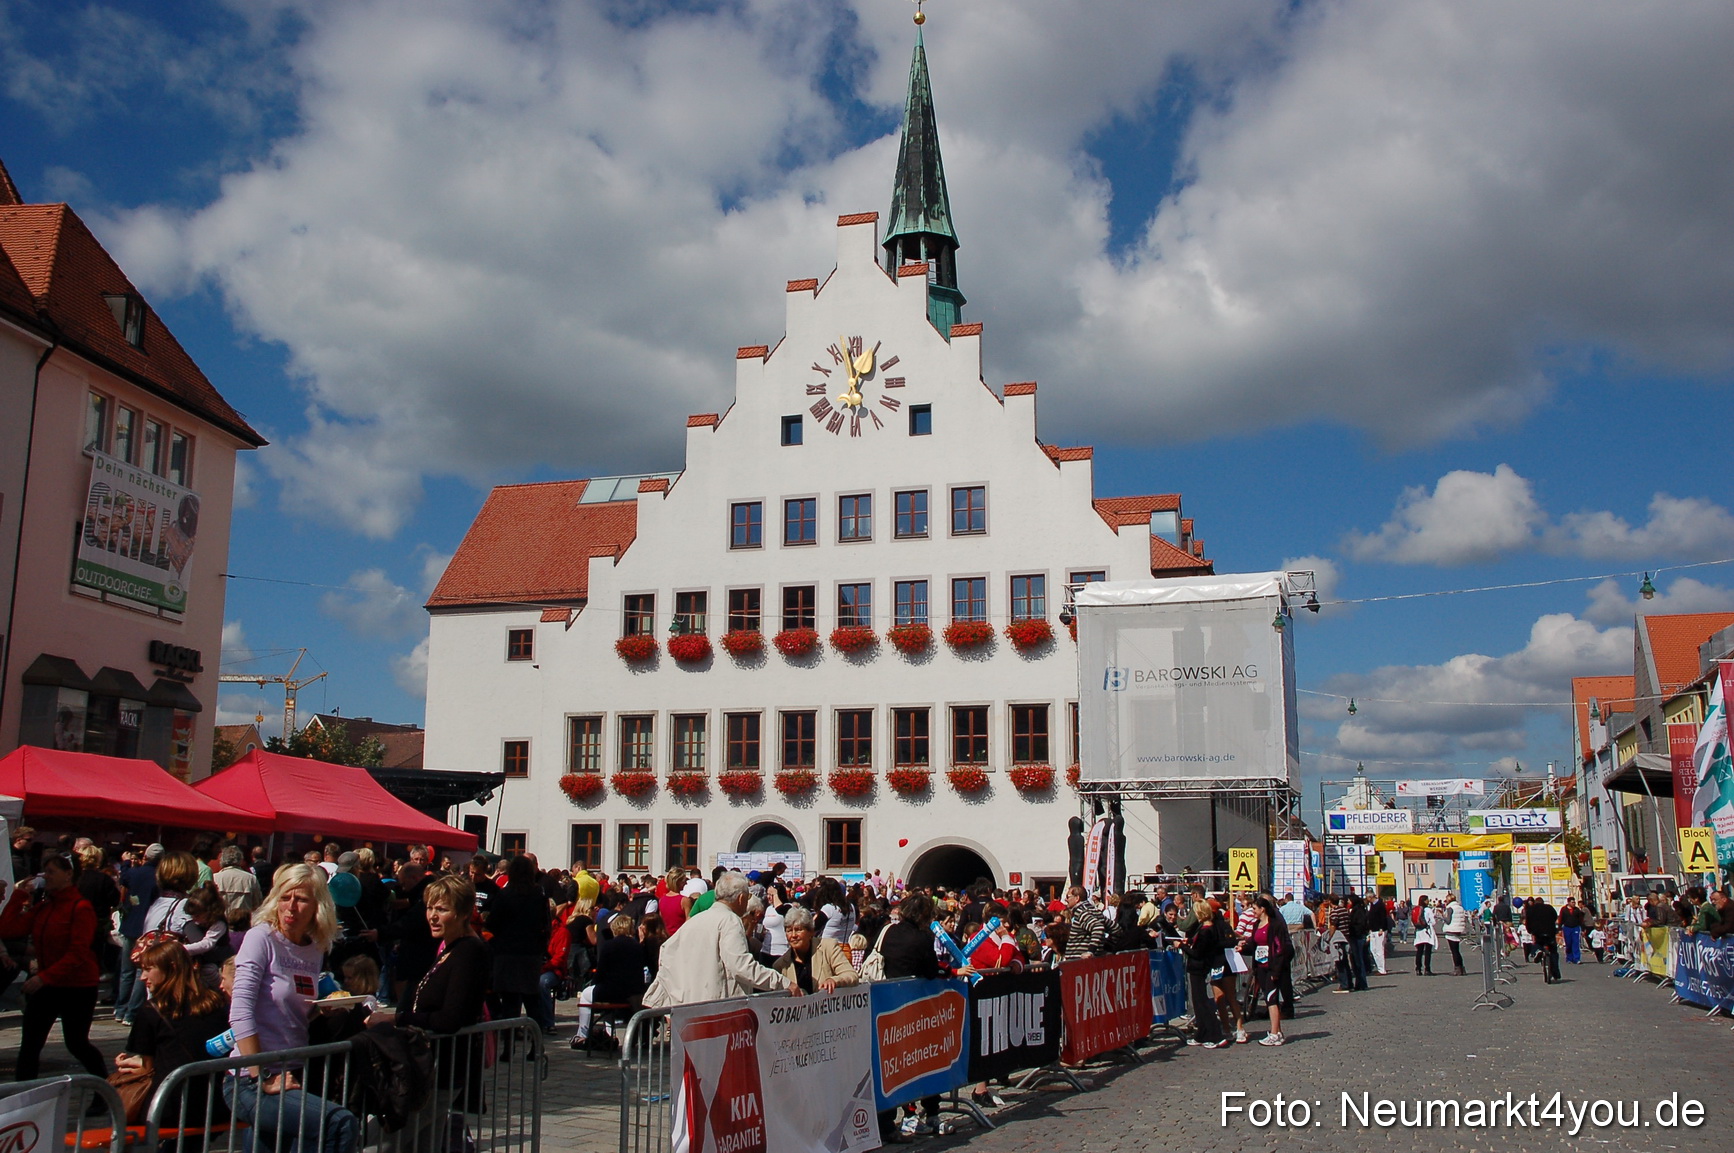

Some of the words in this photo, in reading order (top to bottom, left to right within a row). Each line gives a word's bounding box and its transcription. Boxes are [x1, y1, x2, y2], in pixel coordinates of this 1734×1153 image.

[96, 455, 124, 478] Dein
[128, 473, 178, 500] nächster
[84, 481, 172, 572] GRILL
[76, 567, 152, 598] OUTDOORCHEF
[1134, 666, 1226, 682] BAROWSKI
[1232, 664, 1258, 678] AG
[120, 711, 138, 727] RACKL
[1137, 753, 1236, 764] www.barowski-ag.de
[1346, 812, 1408, 824] PFLEIDERER
[1485, 814, 1548, 828] BOCK
[1428, 837, 1458, 848] ZIEL
[1684, 830, 1710, 838] Block
[1232, 849, 1255, 858] Block
[1690, 840, 1710, 862] A
[1236, 861, 1252, 881] A
[1074, 969, 1114, 1024] PARK
[770, 1008, 784, 1024] SO
[978, 992, 1045, 1056] THULE
[730, 1029, 753, 1052] JAHRE
[882, 1028, 903, 1046] Alles
[902, 1022, 915, 1038] aus
[730, 1092, 760, 1122] KIA
